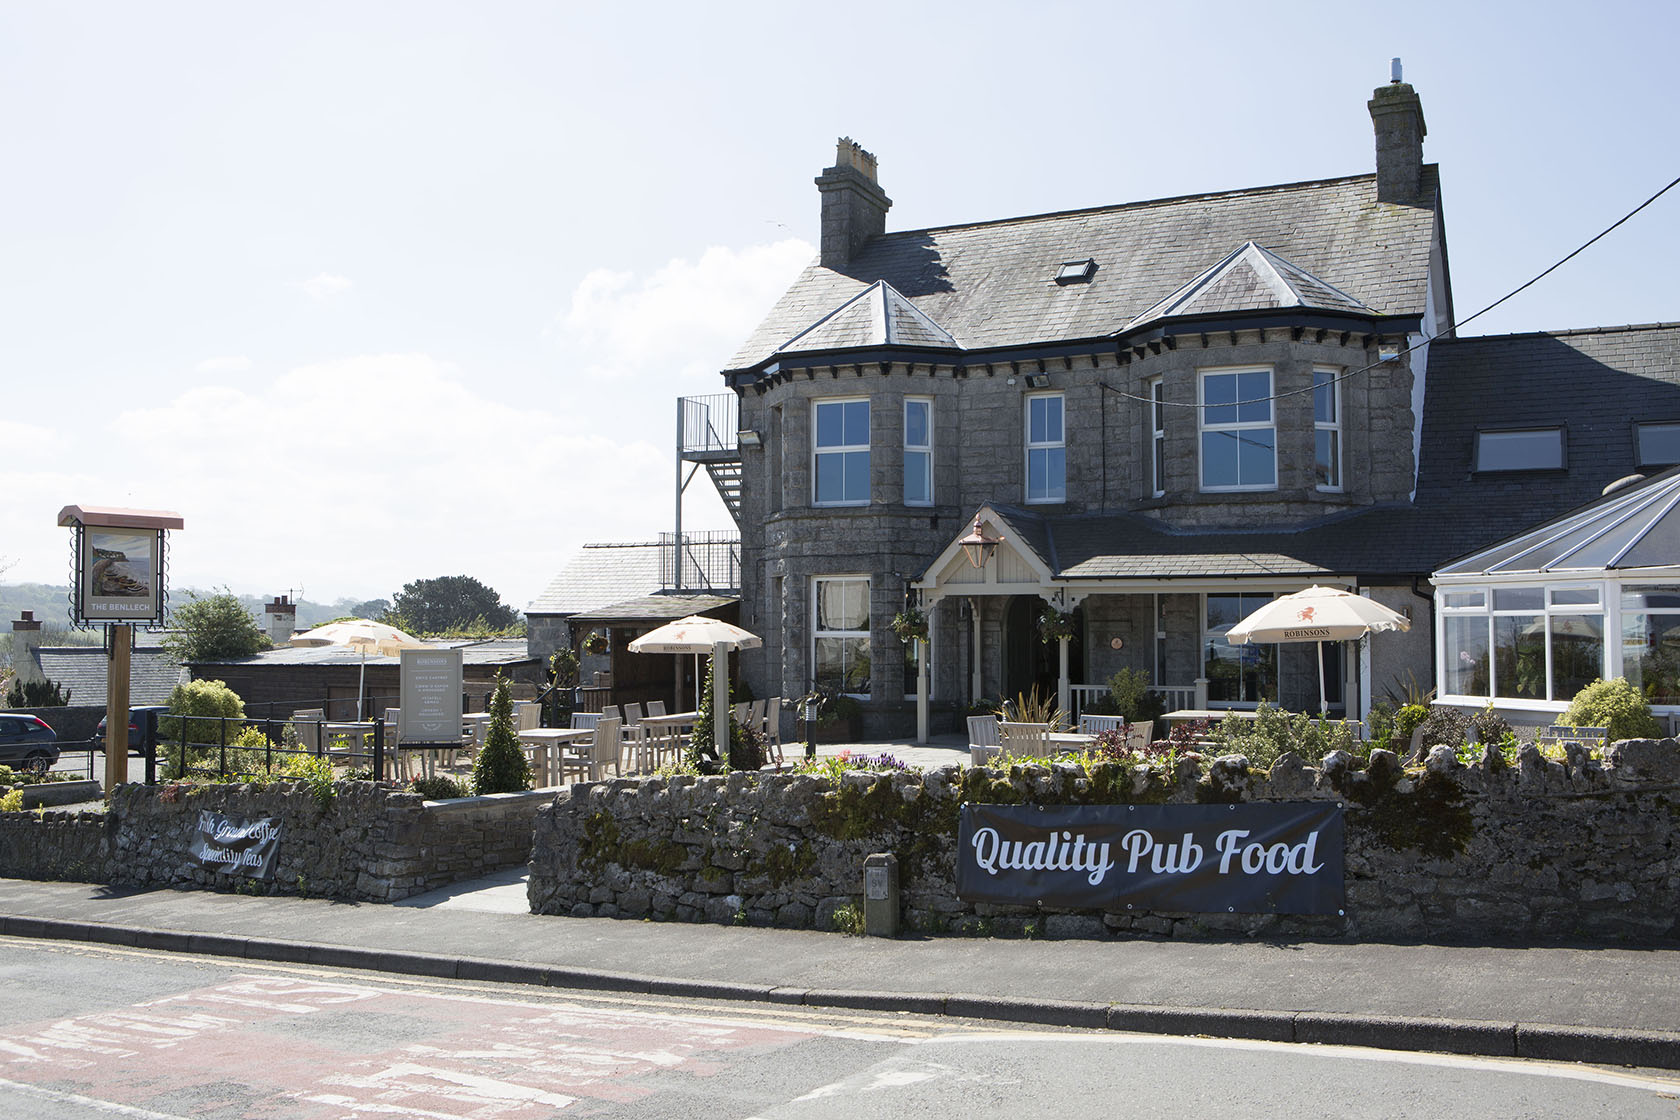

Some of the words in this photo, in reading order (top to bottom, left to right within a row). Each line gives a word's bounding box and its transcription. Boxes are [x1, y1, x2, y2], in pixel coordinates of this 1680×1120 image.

[91, 603, 107, 611] THE
[109, 603, 150, 611] BENLLECH
[1284, 628, 1330, 638] ROBINSONS
[248, 822, 279, 845] Coffee
[242, 848, 264, 867] Teas
[971, 827, 1115, 886] Quality
[1121, 829, 1204, 874] Pub
[1215, 829, 1325, 876] Food
